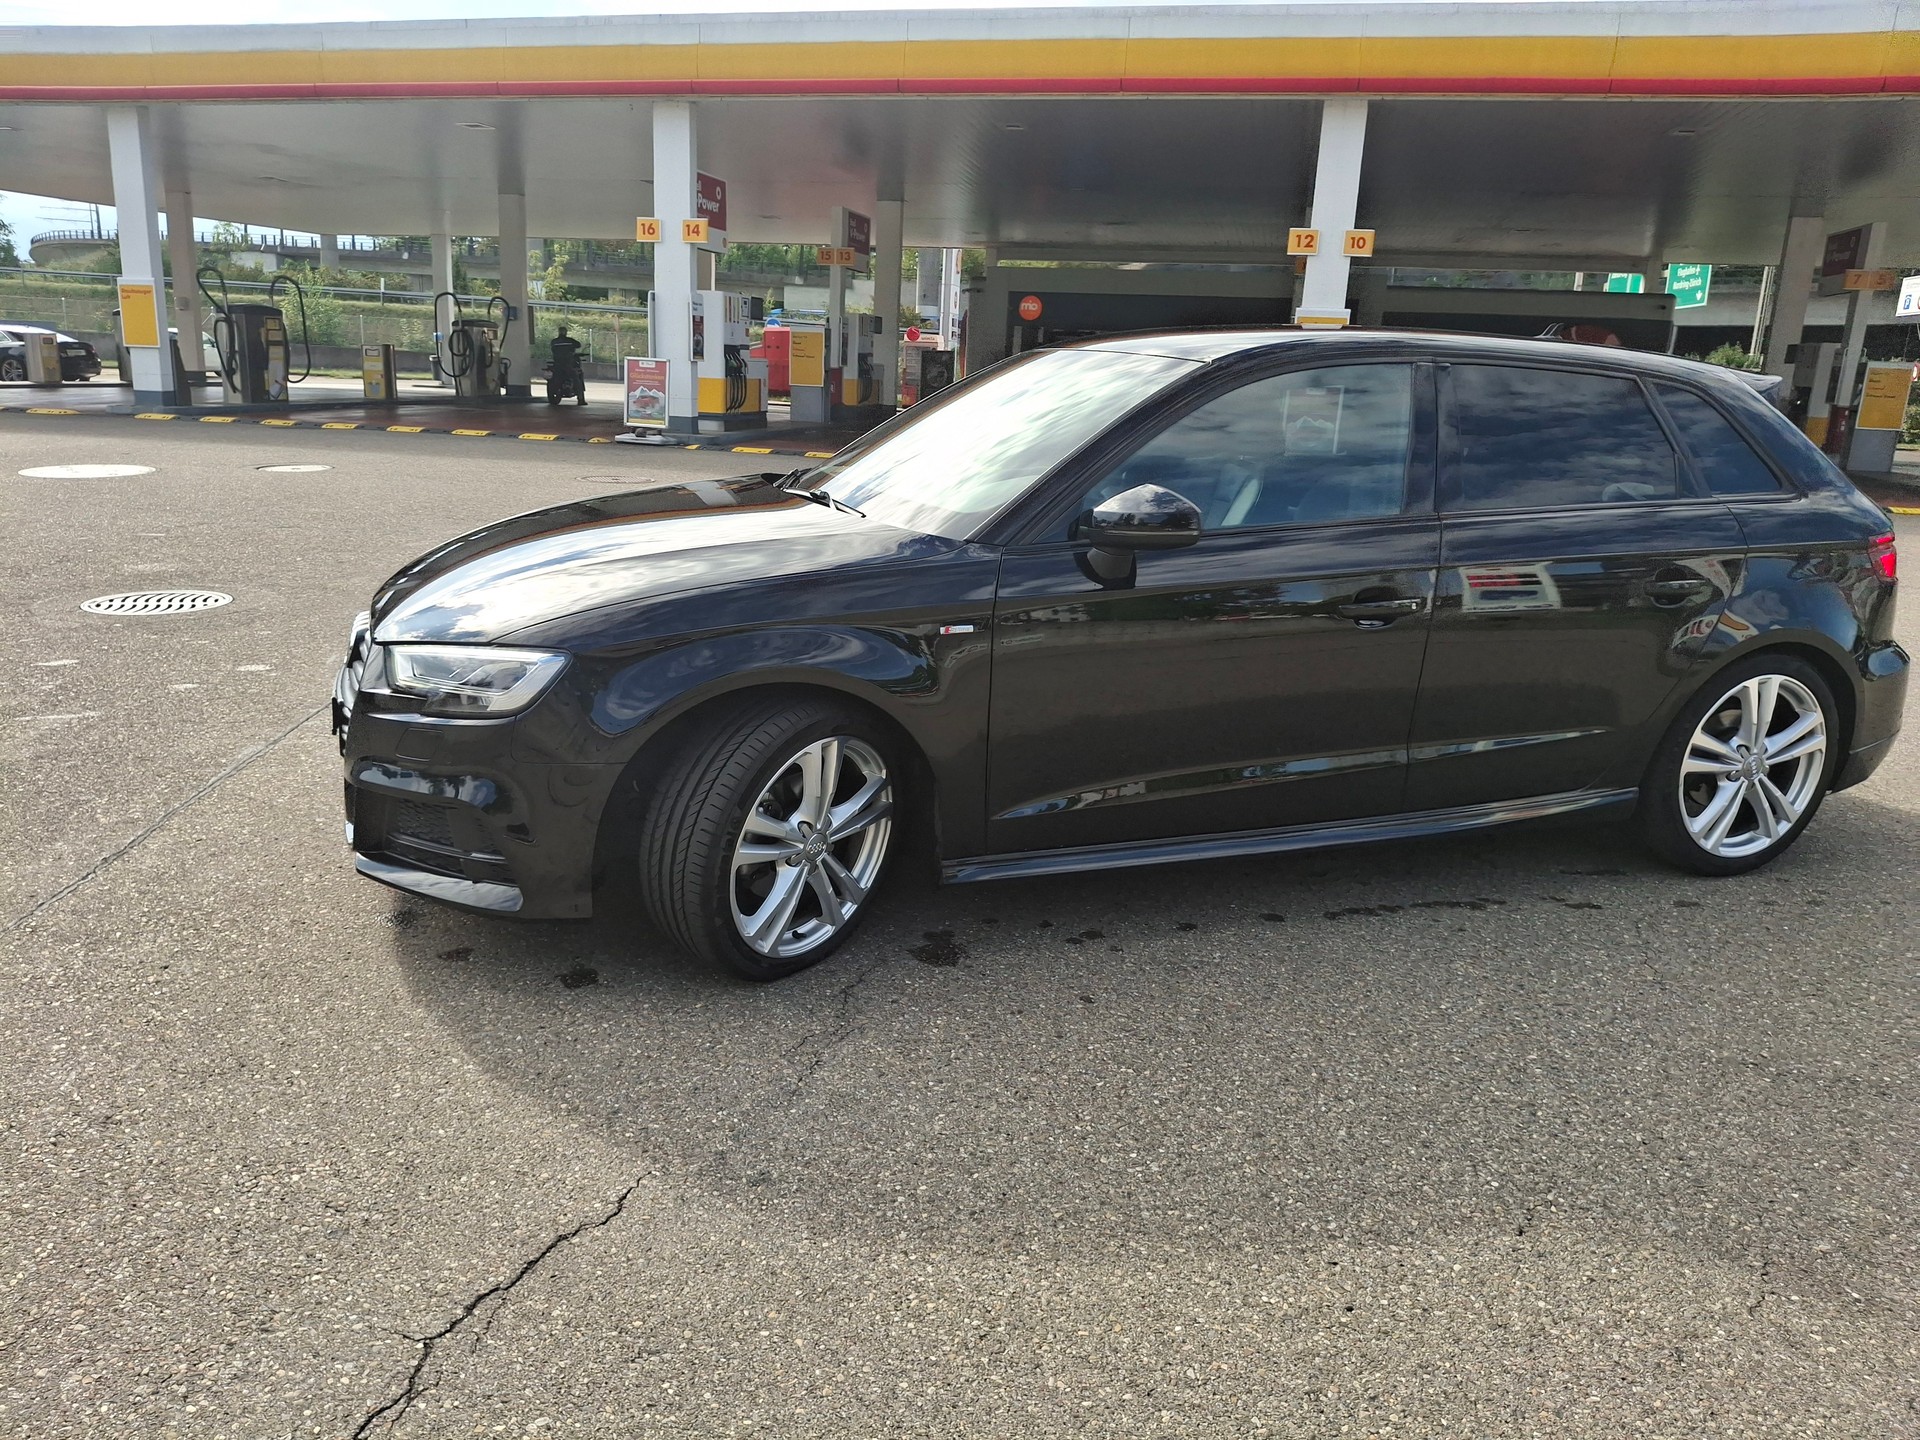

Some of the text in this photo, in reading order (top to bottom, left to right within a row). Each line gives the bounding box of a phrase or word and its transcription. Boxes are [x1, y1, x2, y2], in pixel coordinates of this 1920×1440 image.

[698, 193, 719, 213] -Power
[641, 223, 655, 235] 16
[686, 224, 700, 237] 14
[1296, 234, 1314, 248] 12
[1351, 237, 1366, 249] 10
[821, 251, 831, 260] 15
[840, 251, 851, 261] 13
[1854, 274, 1861, 284] 7
[1877, 274, 1887, 285] 5
